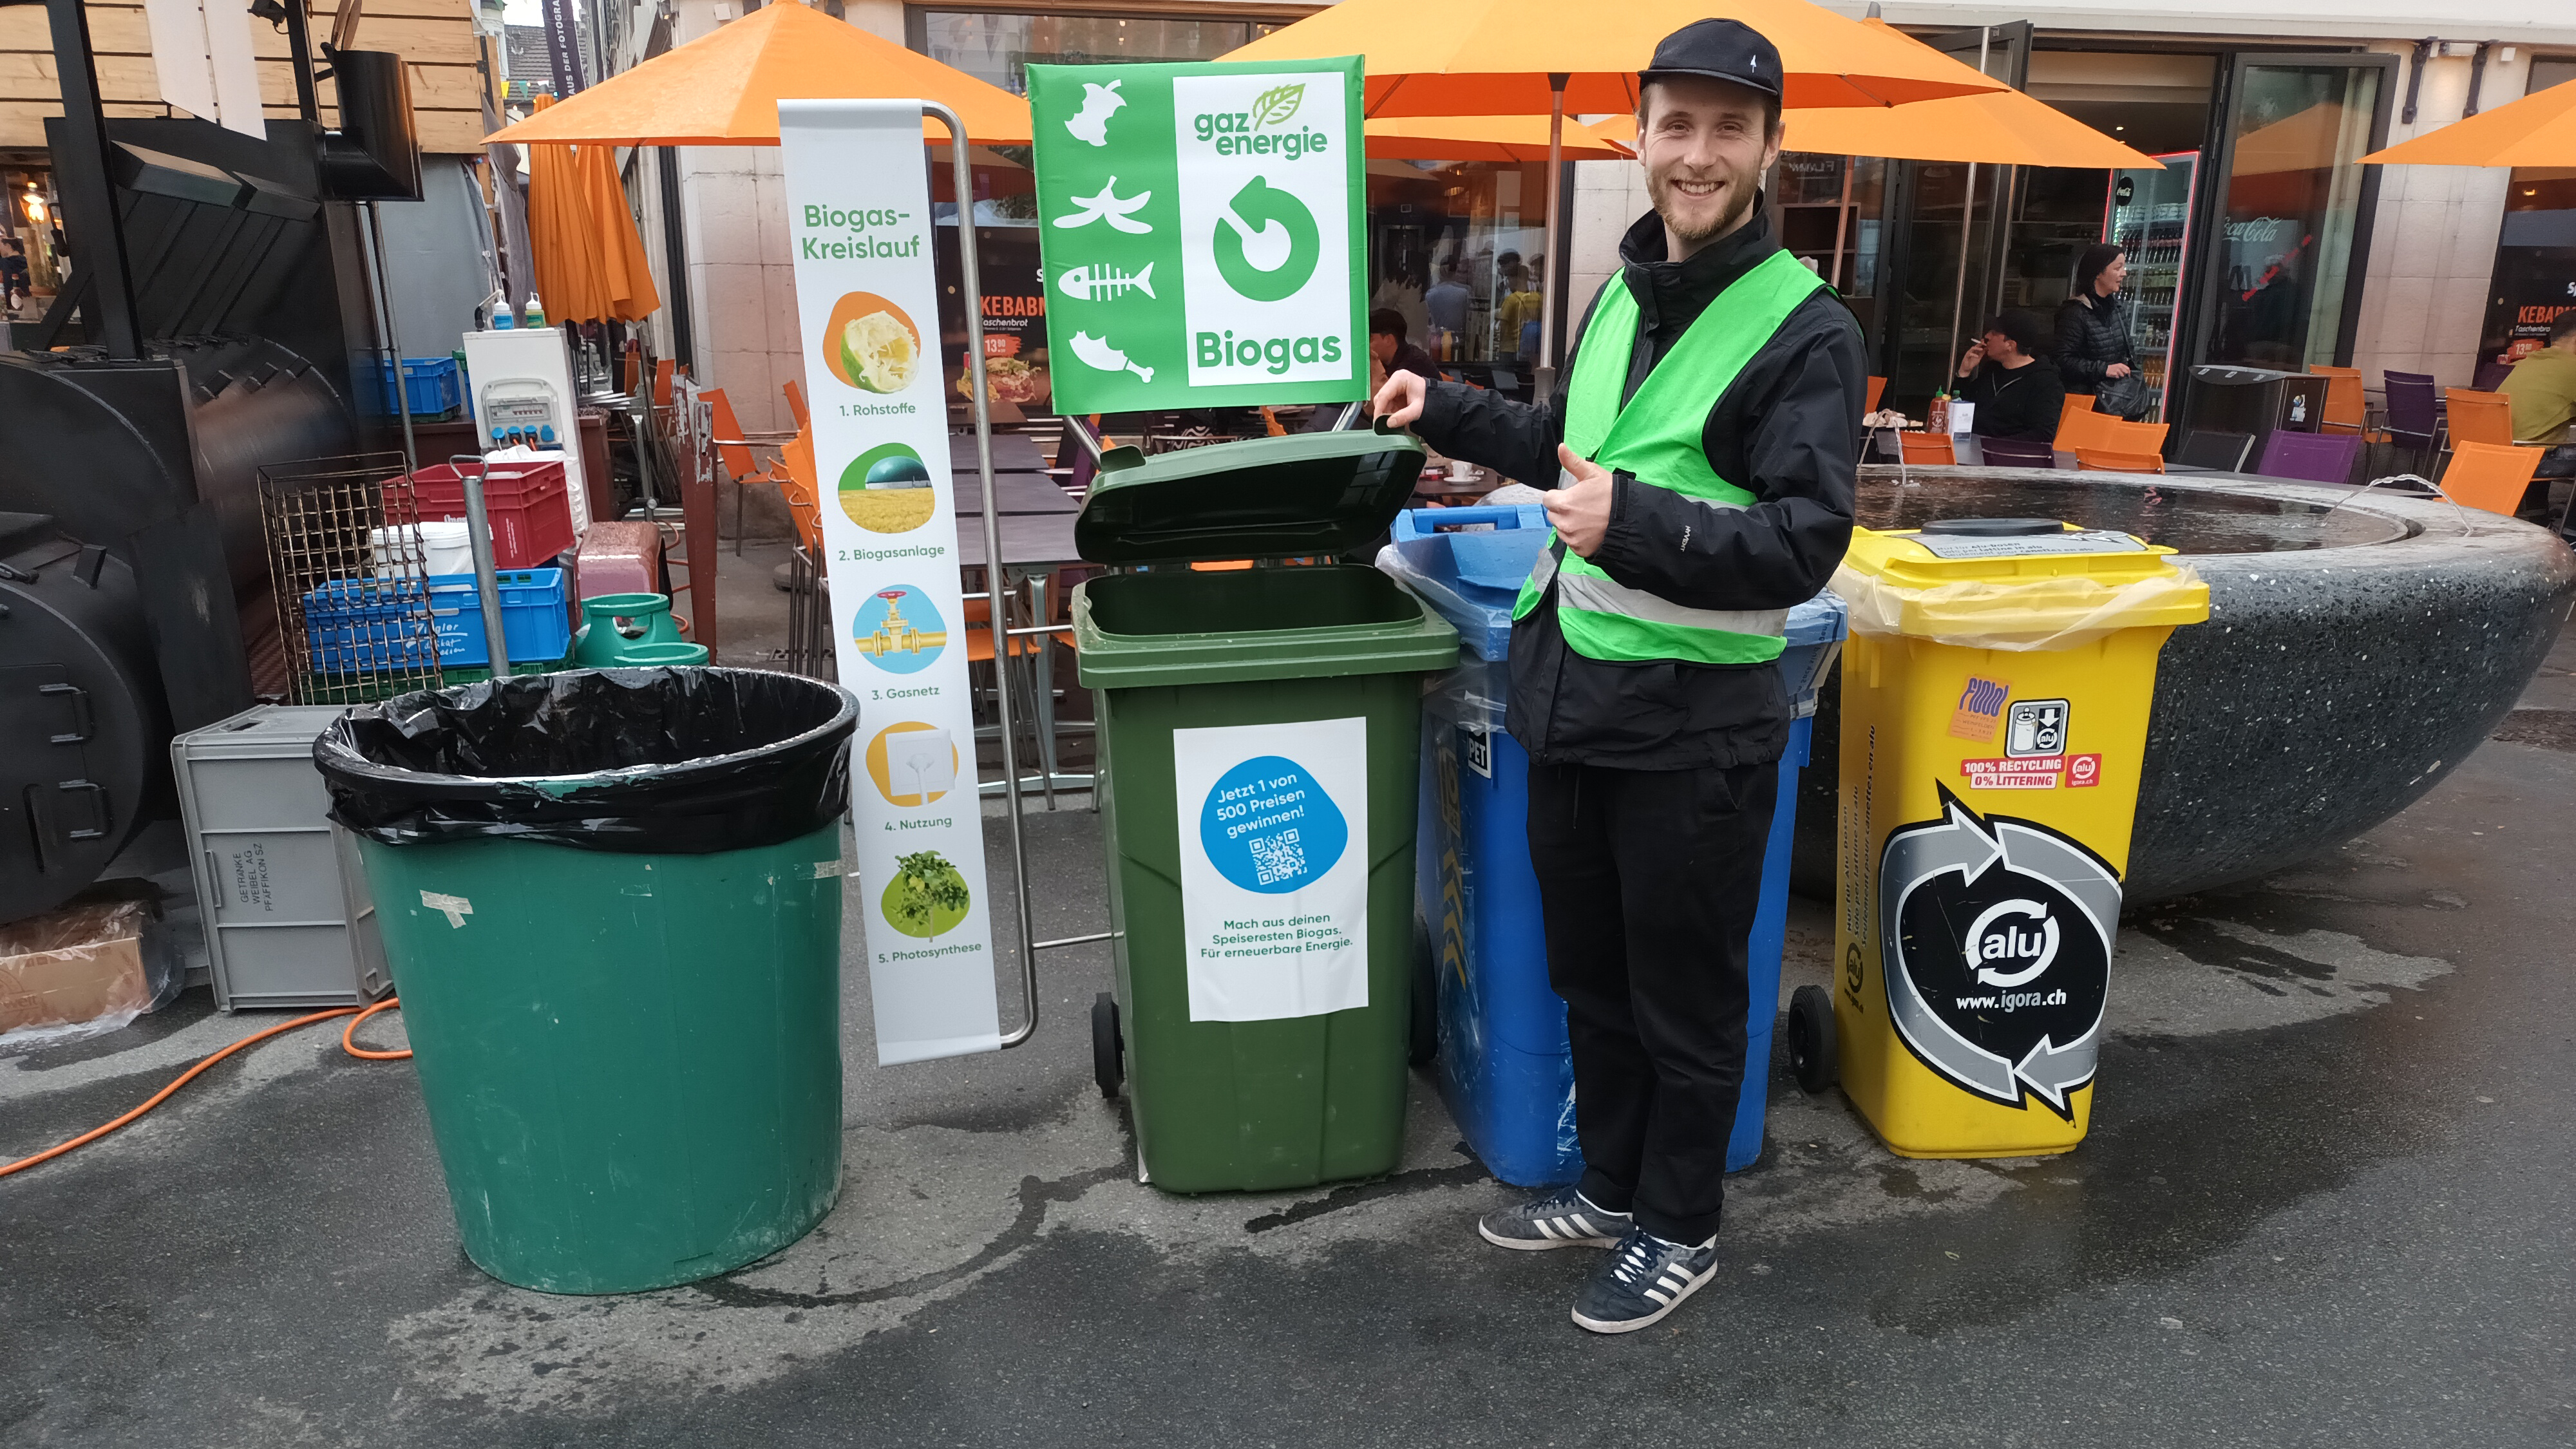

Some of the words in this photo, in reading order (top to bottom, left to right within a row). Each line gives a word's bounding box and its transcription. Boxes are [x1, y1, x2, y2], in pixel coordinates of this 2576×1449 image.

[552, 0, 567, 49] FOTOGRA
[562, 52, 572, 71] DER
[566, 75, 576, 95] AUS
[1194, 111, 1249, 142] gaz
[1215, 125, 1328, 161] energie
[803, 204, 911, 232] Biogas-
[801, 234, 920, 260] Kreislauf
[982, 318, 1028, 327] aschenbrot
[1196, 330, 1343, 375] Biogas
[839, 404, 849, 417] 1.
[853, 402, 916, 417] Rohstoffe
[838, 549, 850, 562] 2.
[853, 543, 945, 562] Biogasanlage
[871, 688, 883, 701] 3.
[886, 685, 940, 699] Gasnetz
[2040, 734, 2054, 742] alu
[1468, 737, 1486, 766] PET
[1964, 762, 1996, 773] 100%
[1998, 759, 2062, 772] RECYCLING
[2077, 763, 2092, 772] alu
[1217, 784, 1255, 803] Jetzt
[1257, 780, 1265, 792] 1
[1269, 773, 1298, 790] von
[1975, 776, 1994, 786] 0%
[1996, 775, 2053, 786] LITTERING
[1217, 805, 1247, 821] 500
[1251, 788, 1306, 813] Preisen
[885, 820, 896, 832] 4.
[899, 815, 952, 832] Nutzung
[1227, 805, 1305, 839] gewinnen!
[1853, 812, 1858, 826] in
[243, 850, 254, 865] AG
[253, 843, 264, 856] SZ
[1861, 873, 1870, 949] Seulement
[1868, 752, 1873, 771] en
[248, 869, 260, 904] WEIBEL
[1224, 918, 1259, 930] Mach
[1262, 917, 1285, 927] aus
[1288, 913, 1331, 925] deinen
[1200, 947, 1221, 958] Für
[1224, 943, 1302, 958] erneuerbare
[1305, 936, 1354, 953] Energie.
[1213, 930, 1293, 947] Speiseresten
[1296, 926, 1342, 940] Biogas.
[1982, 925, 2042, 960] alu
[878, 952, 889, 963] 5.
[892, 941, 982, 963] Photosynthese
[1956, 989, 2067, 1013] www.igora.ch
